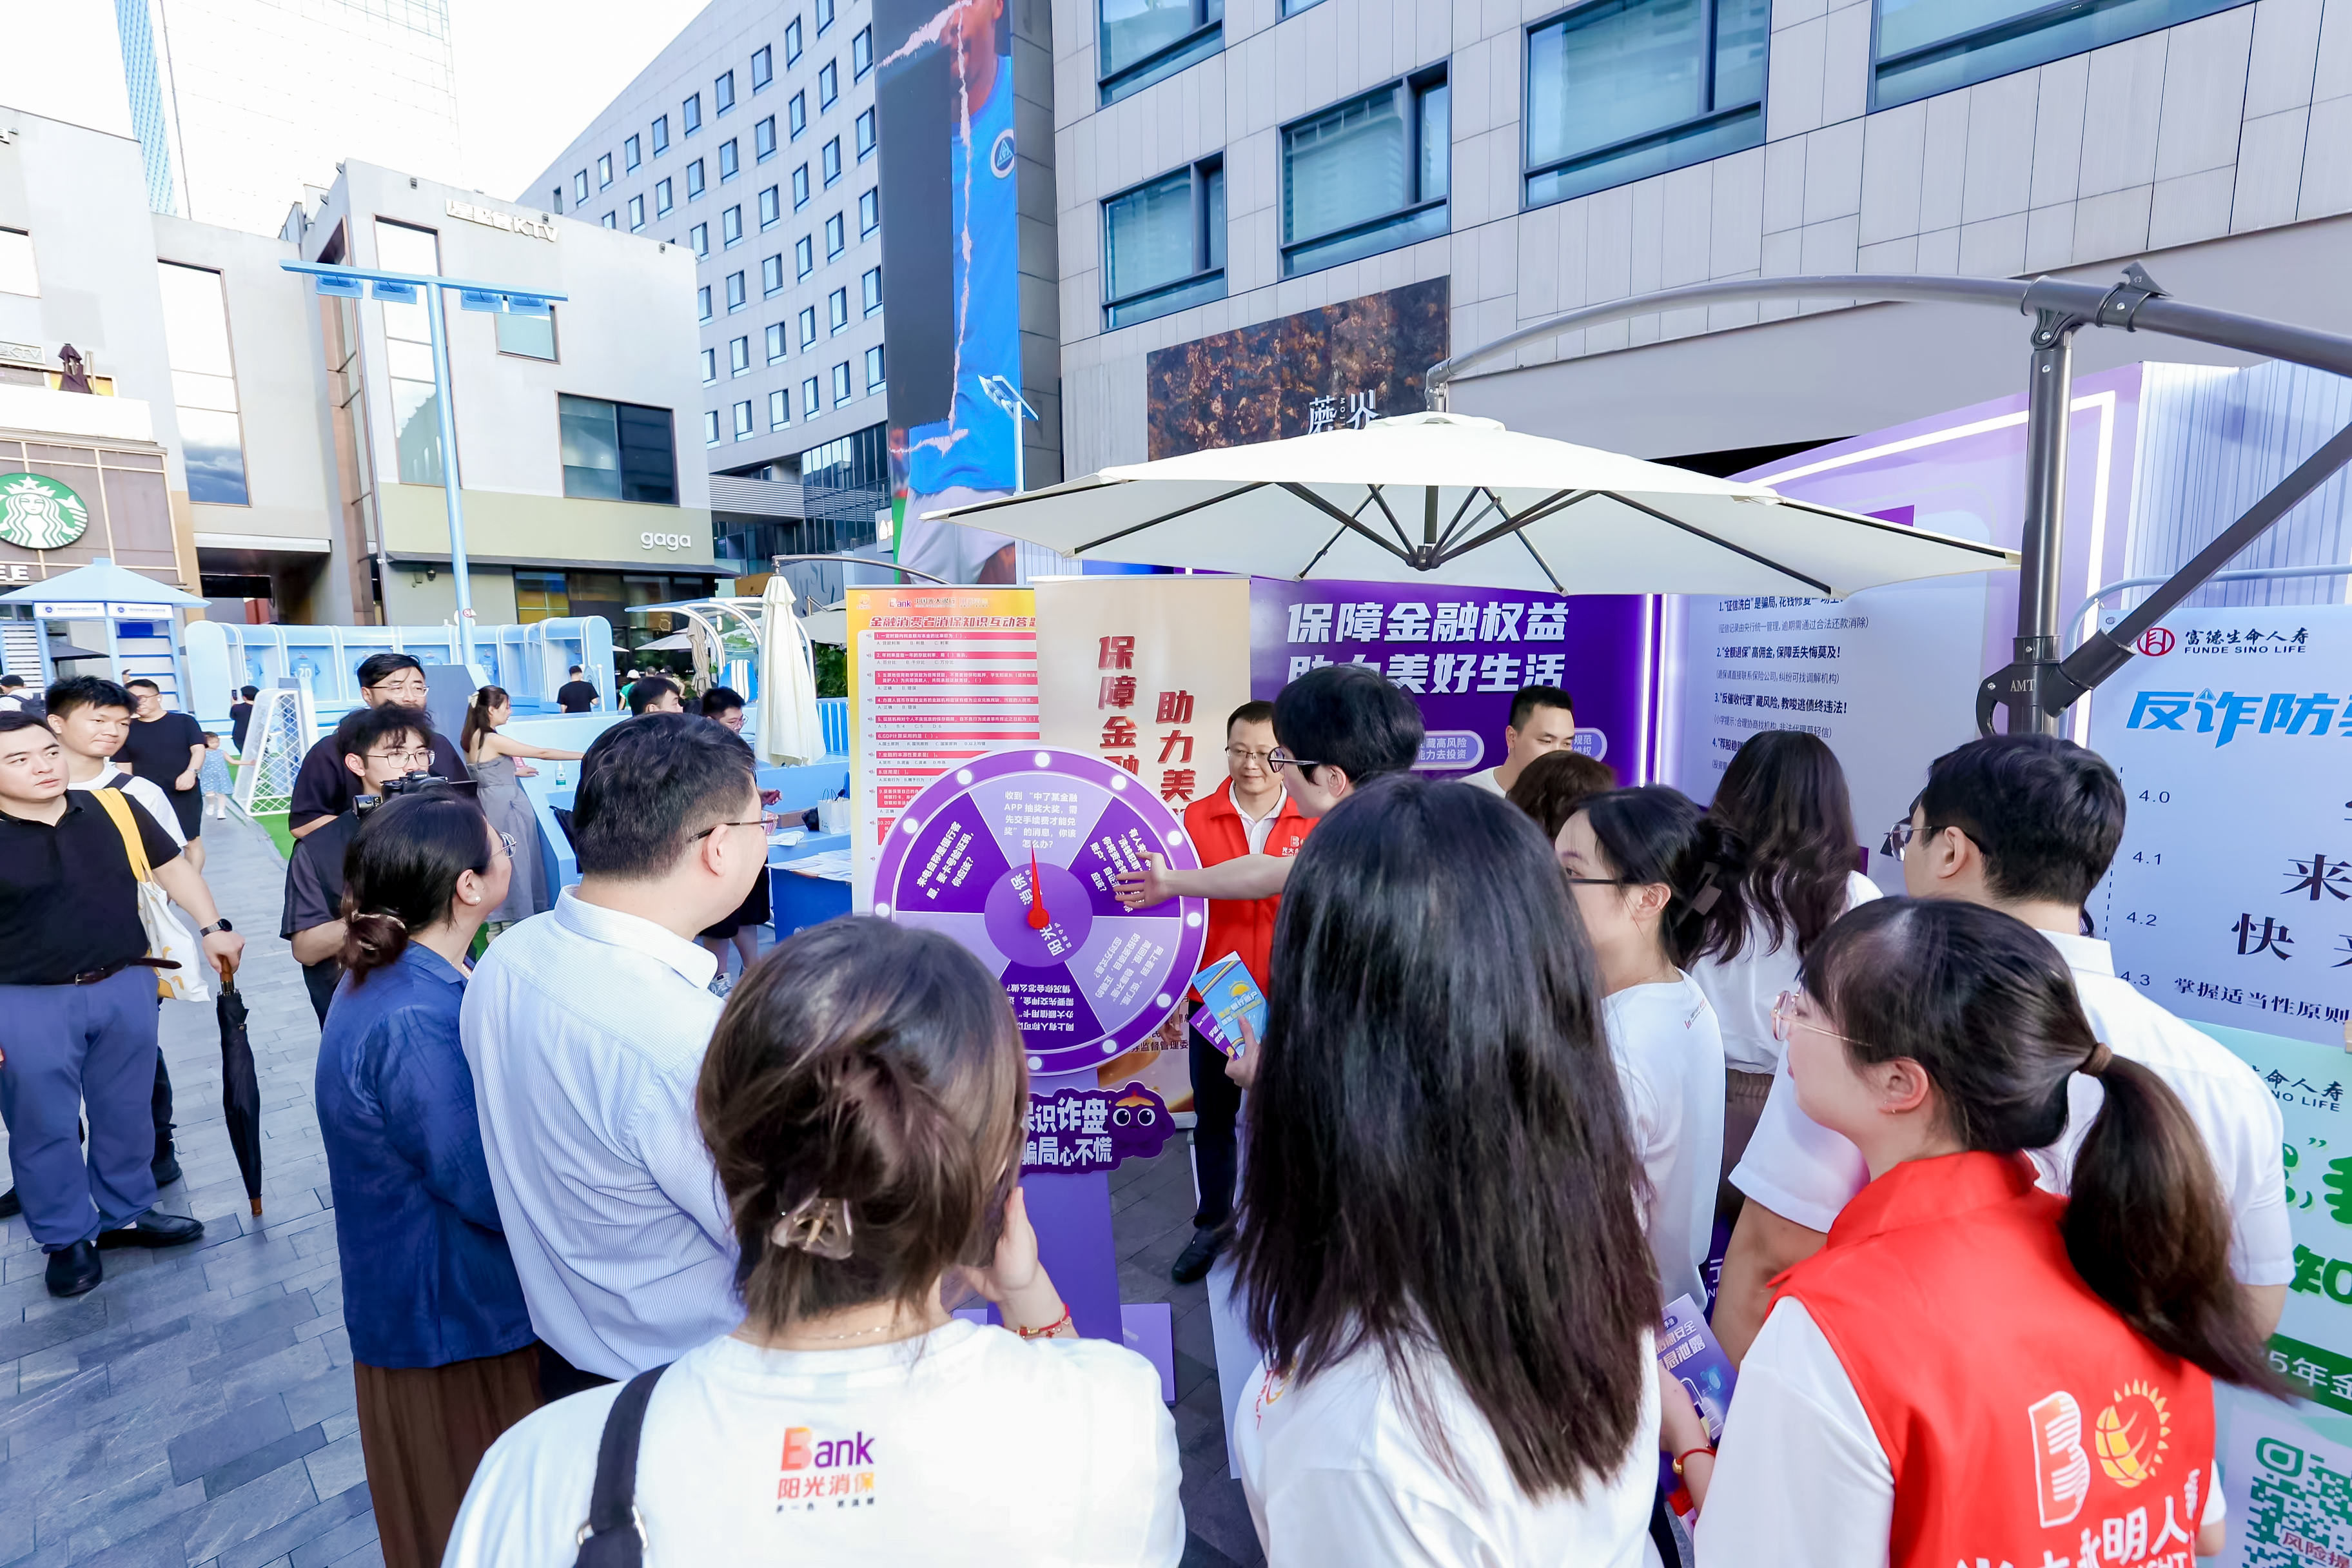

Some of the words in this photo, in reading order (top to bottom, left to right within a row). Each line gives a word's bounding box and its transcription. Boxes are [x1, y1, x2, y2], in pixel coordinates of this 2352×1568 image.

[640, 531, 691, 551] gaga
[1287, 601, 1569, 643] 保障金融权益
[2185, 627, 2309, 645] 富德生命人寿
[2234, 645, 2269, 654] SINO
[2274, 645, 2307, 653] LIFE
[1288, 653, 1565, 694] 助美好生活
[2010, 679, 2035, 692] AMT
[1420, 737, 1467, 749] 藏高风险
[1156, 690, 1196, 814] 助力美
[2139, 790, 2170, 804] 4.0
[2133, 851, 2161, 865] 4.1
[2126, 912, 2157, 926] 4.2
[2120, 971, 2150, 986] 4.3
[2252, 1065, 2344, 1101] 命人寿
[2302, 1096, 2340, 1113] LIFE
[780, 1426, 875, 1471] Bank
